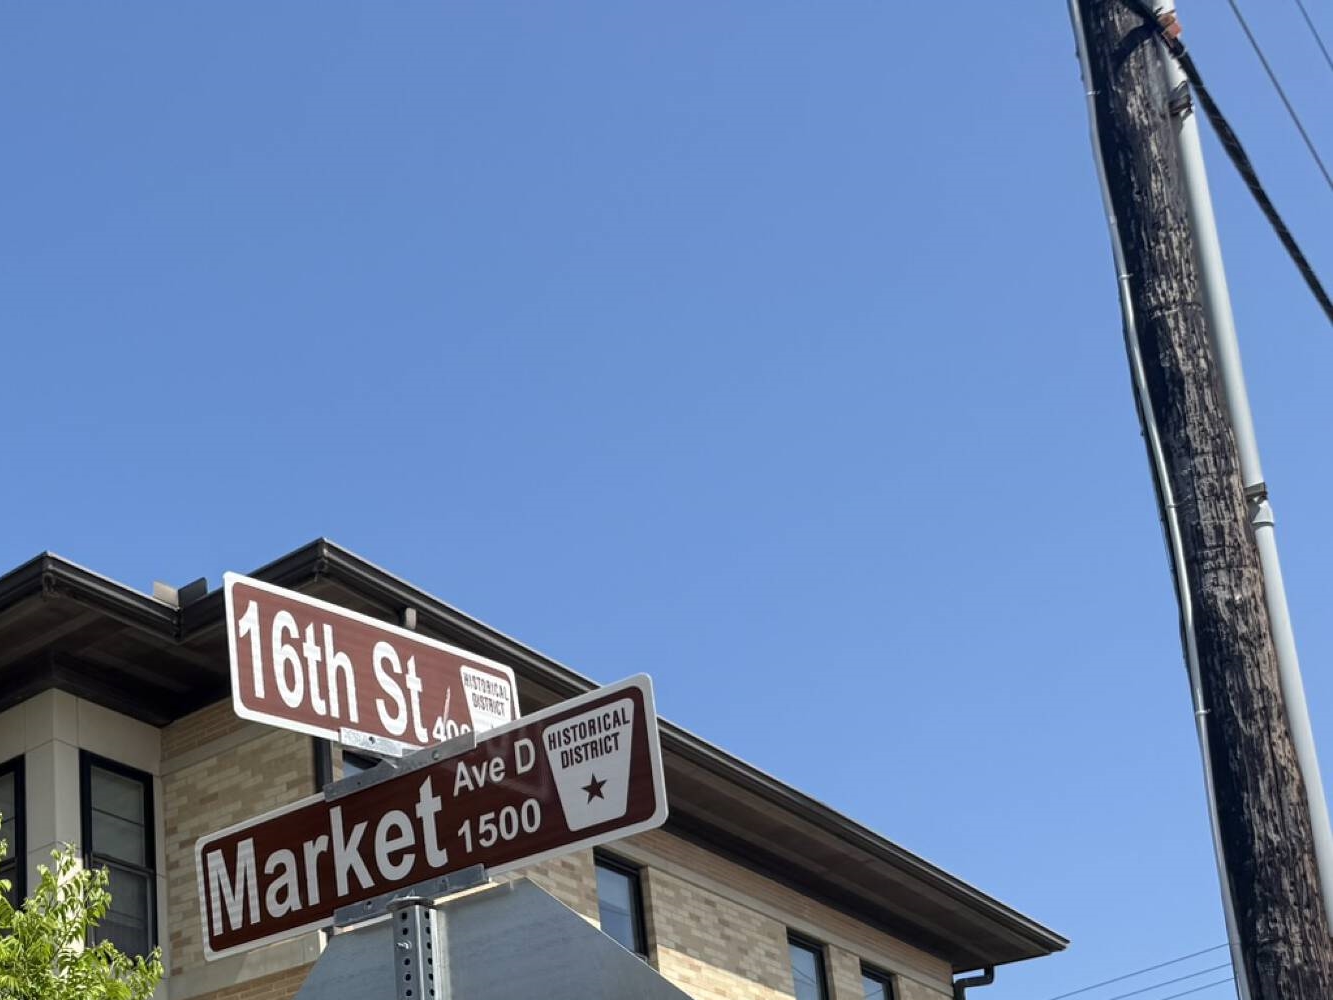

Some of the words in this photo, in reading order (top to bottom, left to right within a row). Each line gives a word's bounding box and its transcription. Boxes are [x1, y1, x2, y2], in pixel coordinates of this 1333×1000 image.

[238, 599, 360, 725] 16th
[372, 641, 429, 744] St
[462, 671, 510, 702] HISTORICAL
[471, 693, 506, 719] DISTRICT
[547, 706, 631, 751] HISTORICAL
[452, 756, 506, 797] Ave
[513, 741, 536, 775] D
[560, 731, 620, 769] DISTRICT
[457, 797, 542, 854] 1500
[206, 775, 449, 937] Market
